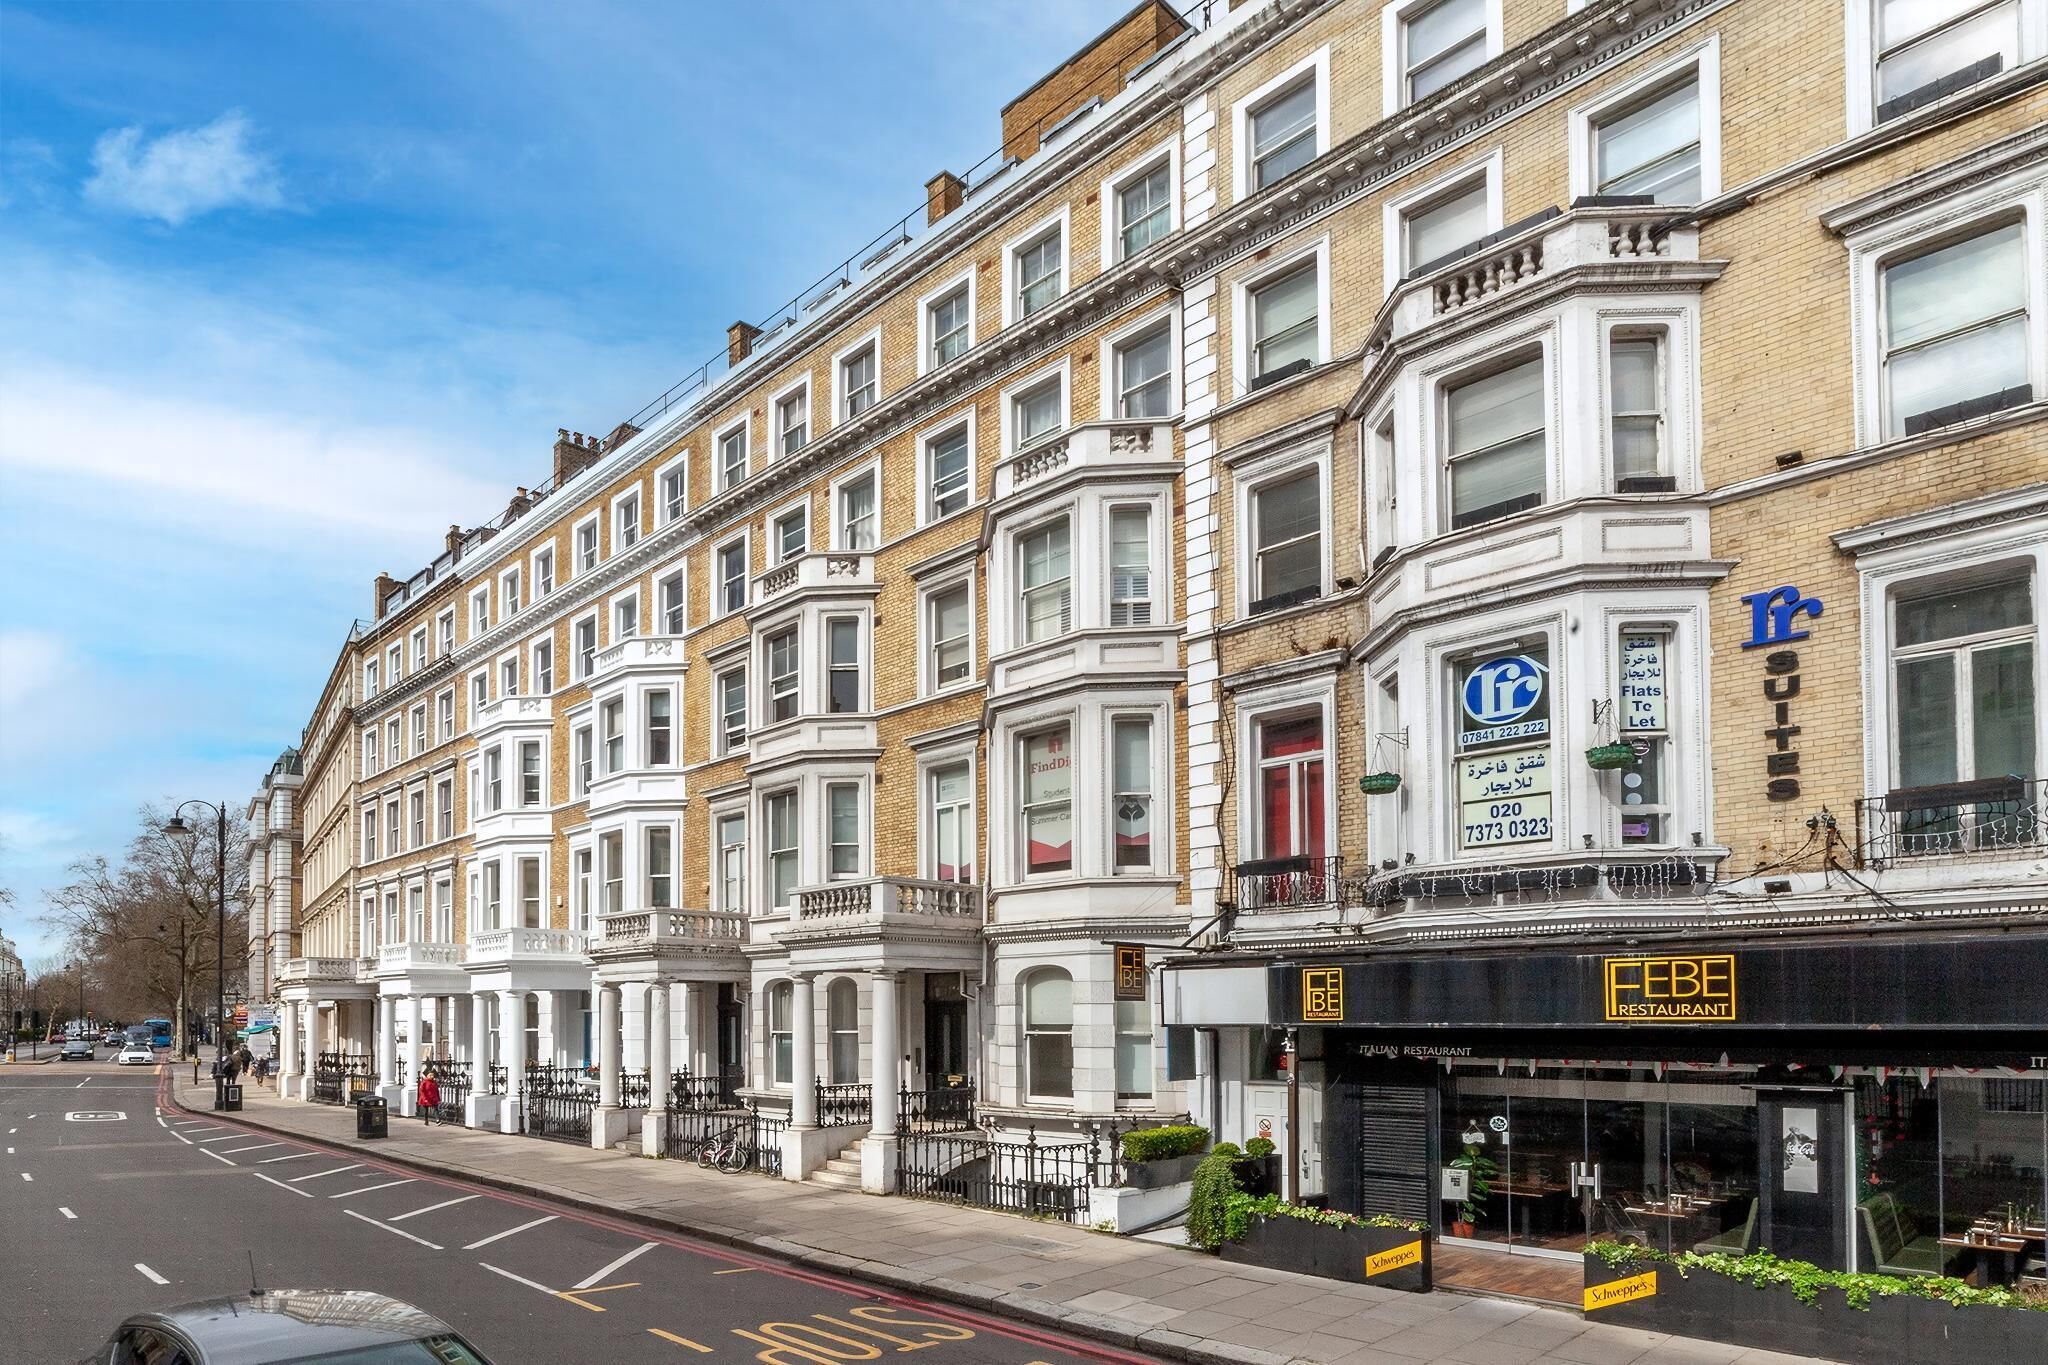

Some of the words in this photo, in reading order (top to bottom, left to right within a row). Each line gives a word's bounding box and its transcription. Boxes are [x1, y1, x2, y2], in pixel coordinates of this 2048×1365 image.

[1624, 653, 1658, 667] فاخرة
[1622, 685, 1662, 697] Flats
[1632, 700, 1652, 712] To
[1629, 715, 1656, 728] Let
[1764, 650, 1801, 802] SUITES
[1462, 729, 1495, 744] 07841
[1500, 725, 1520, 738] 222
[1523, 721, 1545, 735] 222
[1031, 757, 1071, 773] FindDi
[1468, 760, 1508, 780] فاخرة
[1515, 753, 1546, 774] شقق
[1490, 802, 1522, 819] 020
[1465, 822, 1504, 843] 7373
[1509, 817, 1549, 838] 0323
[1607, 959, 1729, 1016] FEBE
[1618, 1003, 1729, 1017] RESTAURANT
[1403, 1046, 1472, 1057] RESTAURANT
[2030, 1056, 2048, 1068] IT
